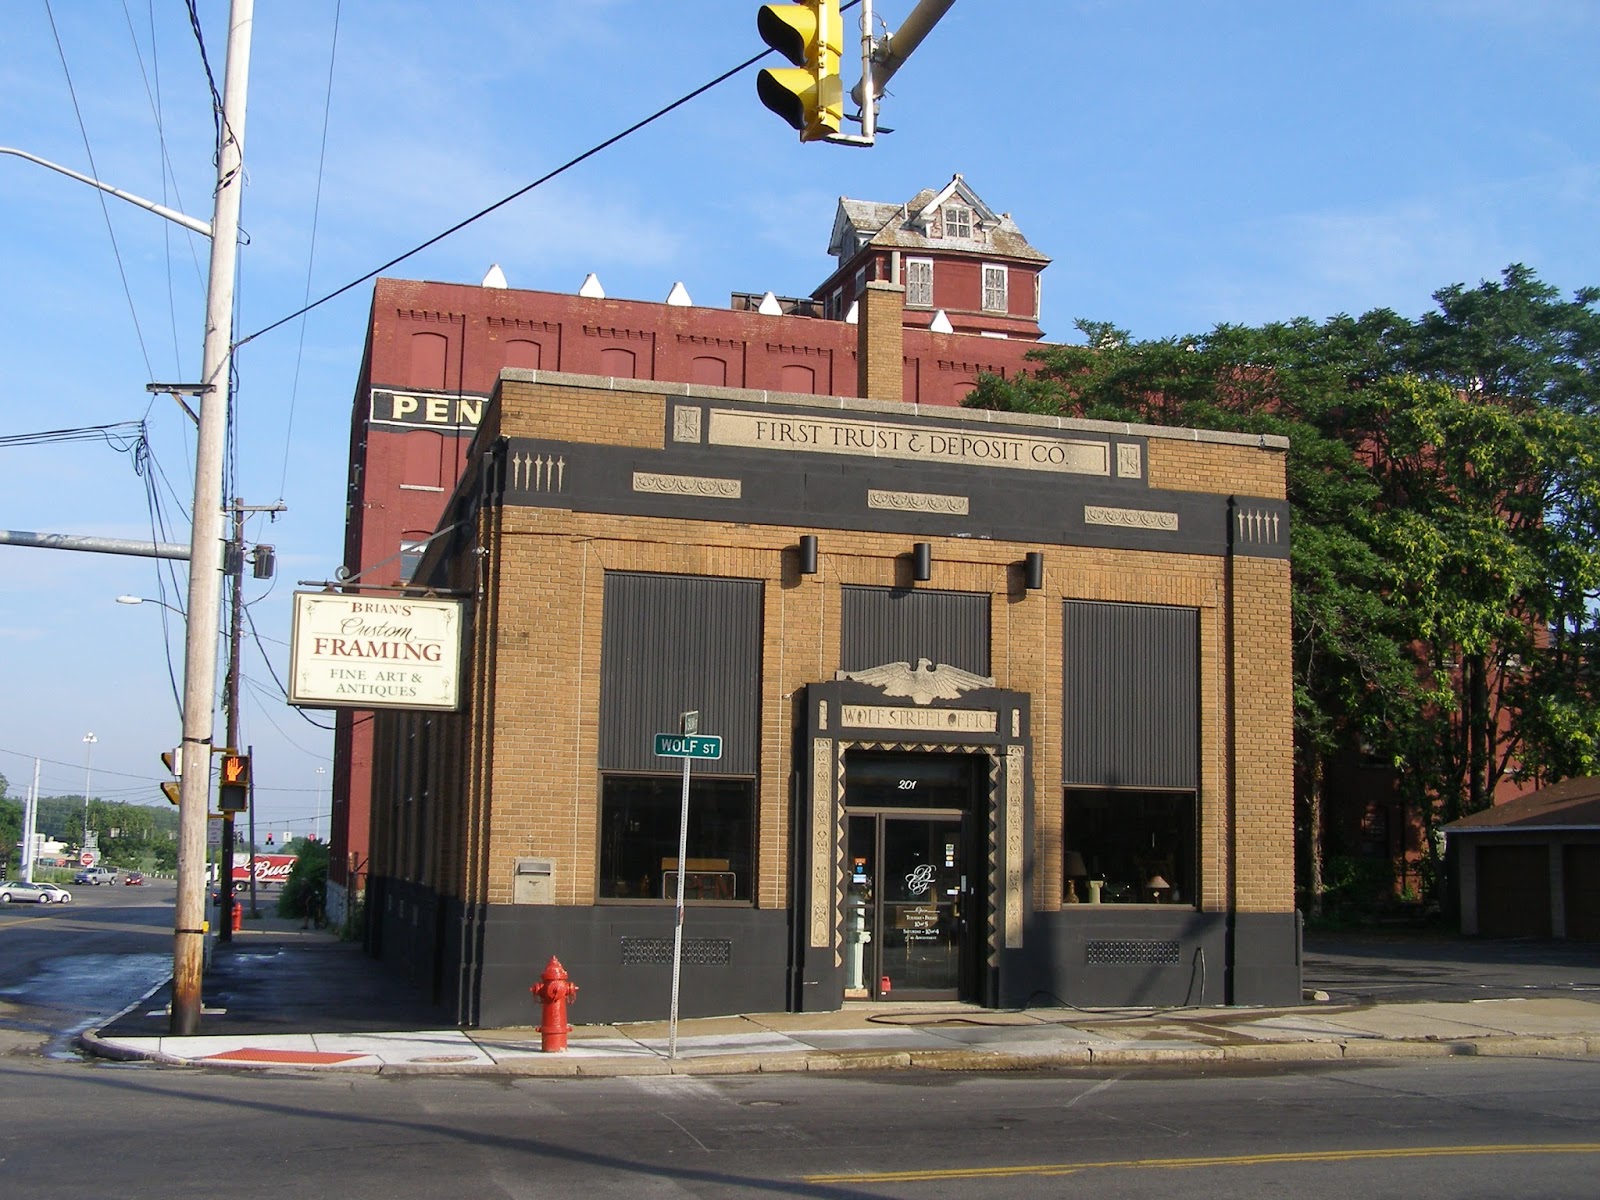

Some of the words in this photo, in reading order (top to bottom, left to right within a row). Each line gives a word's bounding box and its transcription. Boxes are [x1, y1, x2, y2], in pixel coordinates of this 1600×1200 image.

[392, 395, 483, 425] PEN
[756, 421, 822, 444] FIRST
[829, 426, 902, 450] TRUST
[908, 434, 925, 452] &
[930, 435, 1022, 461] DEPOSIT
[1031, 444, 1069, 465] CO.
[352, 602, 411, 616] BRIAN'S
[340, 617, 417, 643] Custom
[313, 637, 441, 662] FRAMING
[330, 668, 366, 681] FINE
[375, 671, 406, 683] ART
[411, 673, 422, 683] &
[336, 683, 417, 698] ANTIQUES
[844, 708, 884, 724] WOLF
[888, 710, 946, 727] STREET
[947, 712, 997, 730] OFFICE
[661, 738, 698, 753] WOLF
[702, 743, 716, 754] ST
[897, 779, 917, 790] 201
